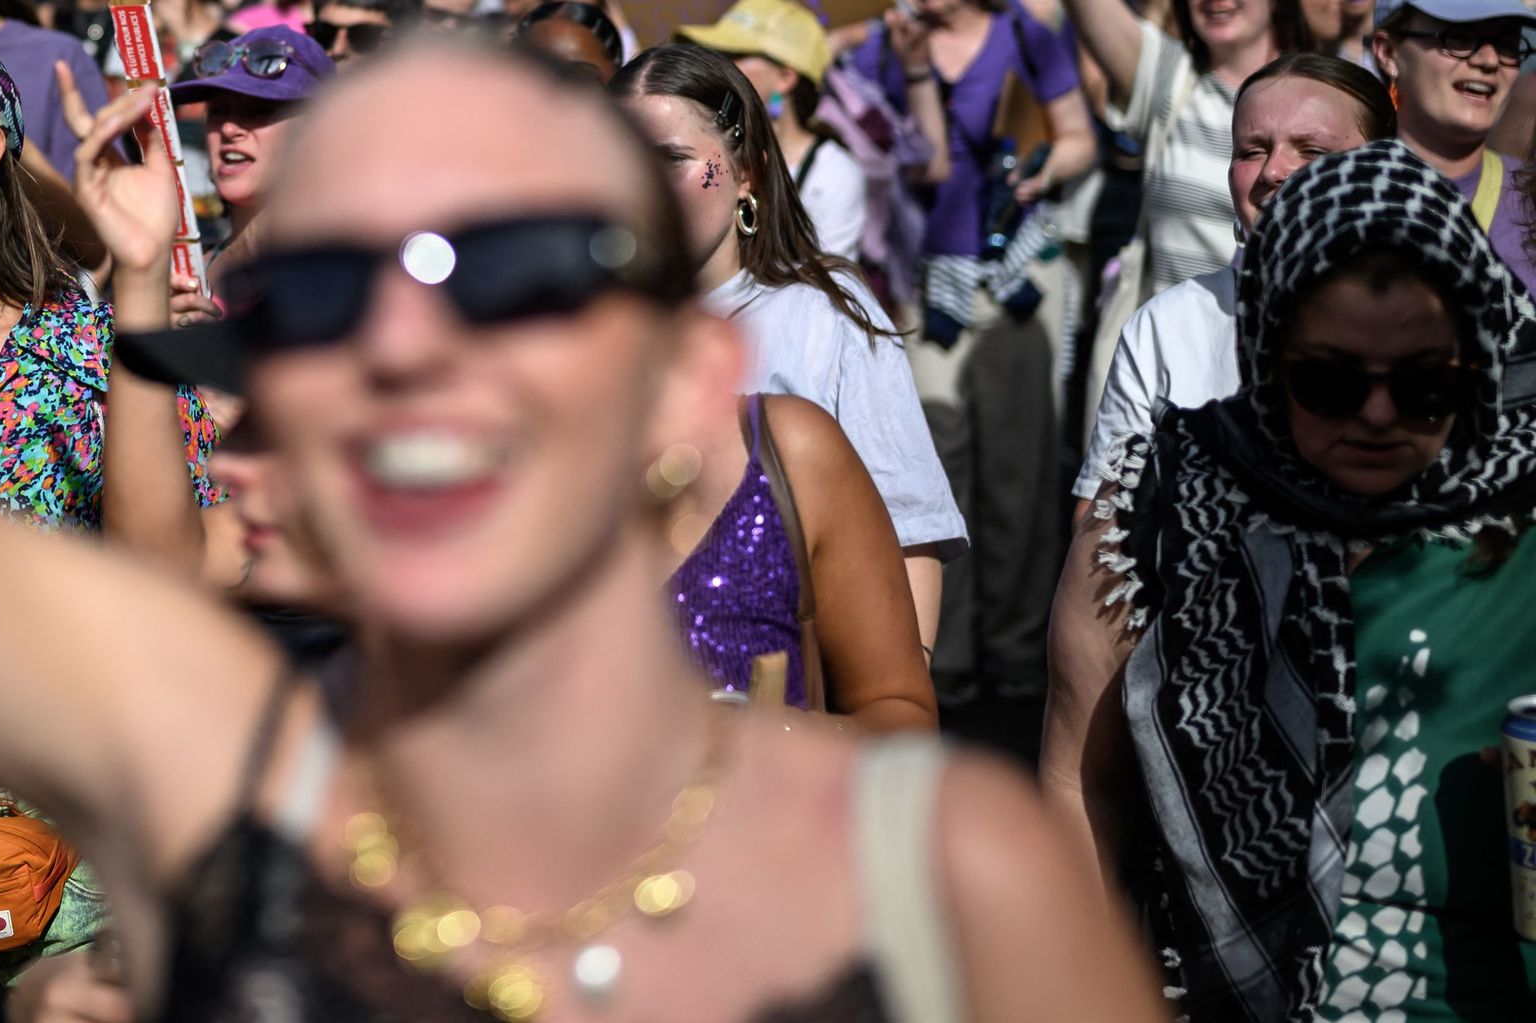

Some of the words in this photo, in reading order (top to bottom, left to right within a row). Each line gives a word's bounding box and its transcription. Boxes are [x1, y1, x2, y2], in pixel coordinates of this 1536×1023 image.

[117, 10, 128, 26] NOS
[129, 15, 143, 43] PUBLICS
[122, 26, 133, 46] POUR
[136, 42, 150, 75] SERVICES
